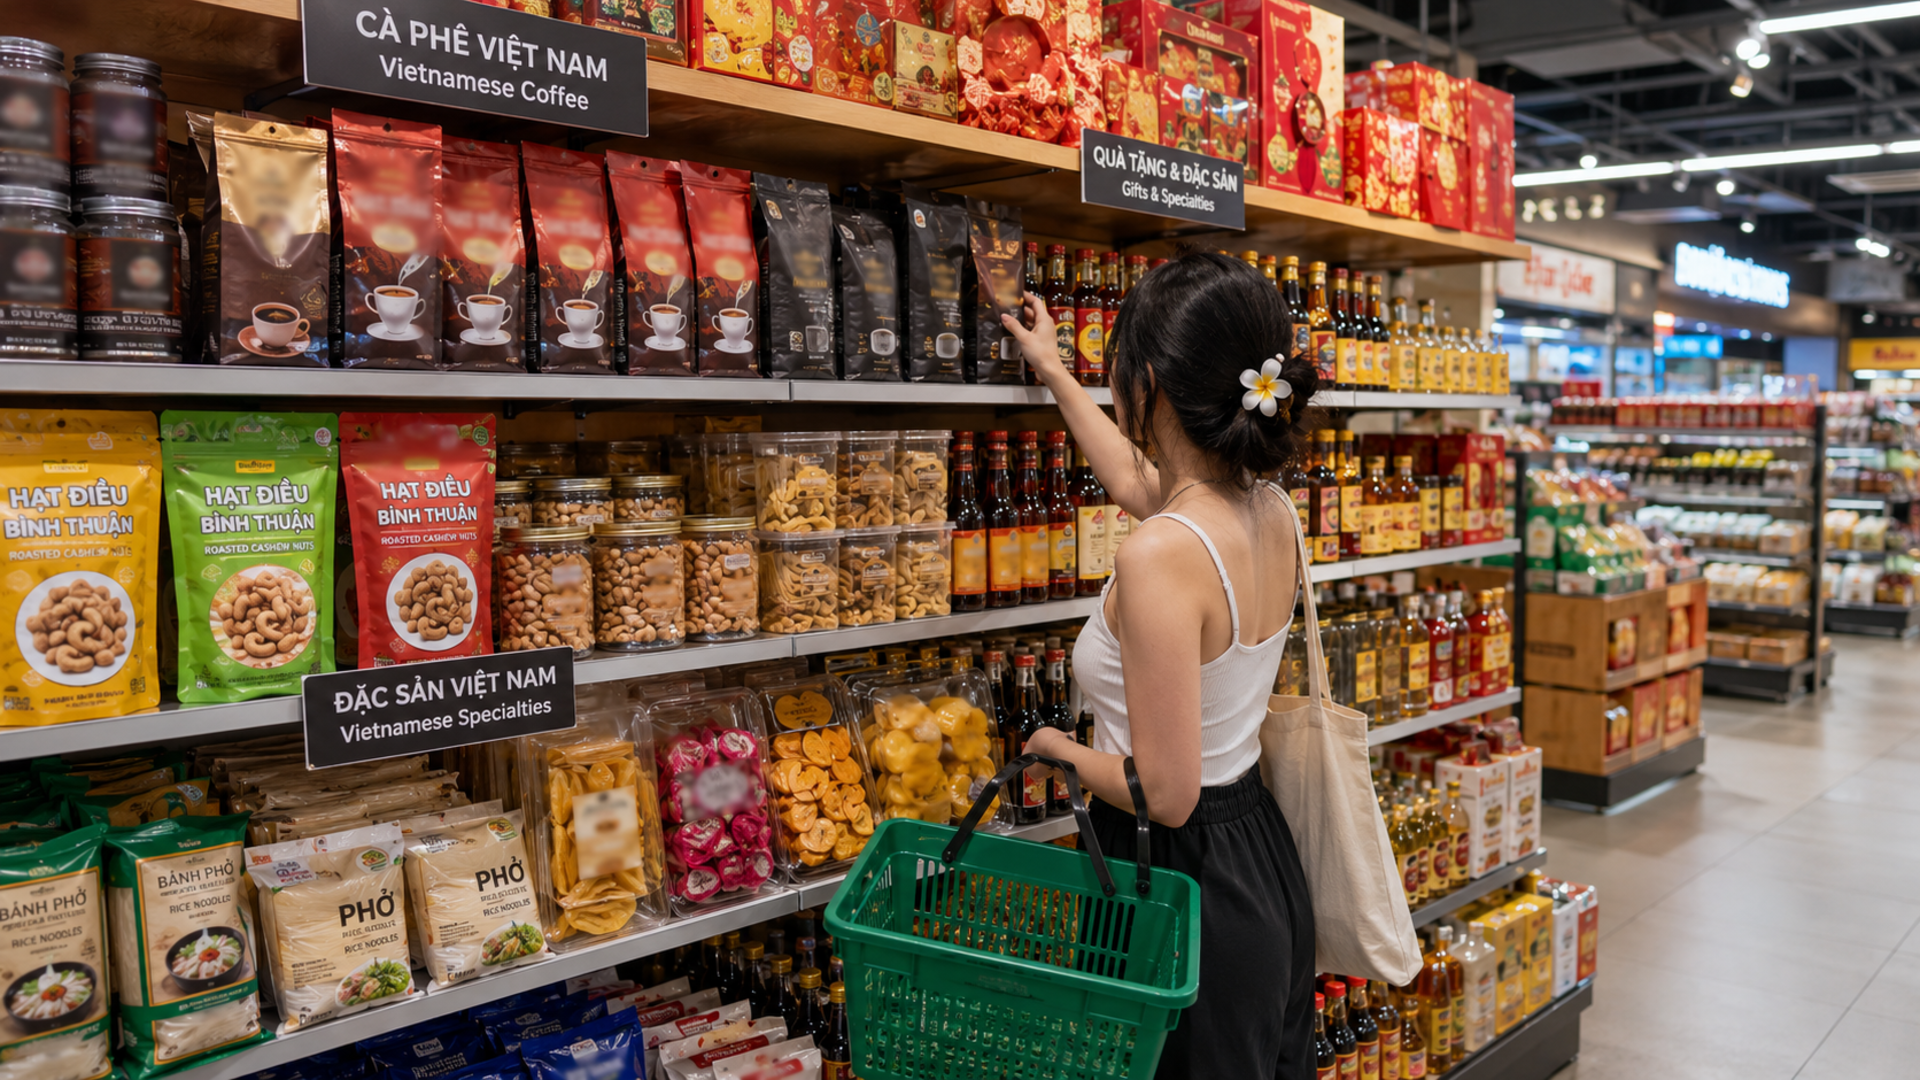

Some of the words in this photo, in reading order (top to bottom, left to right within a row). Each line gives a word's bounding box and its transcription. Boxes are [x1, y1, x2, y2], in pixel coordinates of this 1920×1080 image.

[356, 7, 401, 44] CÀ
[410, 20, 470, 56] PHÊ
[477, 34, 539, 71] VIỆT
[547, 48, 608, 82] NAM
[379, 55, 515, 98] Vietnamese
[521, 80, 589, 110] Coffee
[1093, 145, 1127, 170] QUÀ
[1128, 150, 1167, 178] TẶNG
[1169, 162, 1181, 182] &
[1182, 162, 1210, 190] ĐẶC
[1212, 167, 1238, 193] SẢN
[1122, 180, 1149, 200] Gifts
[1150, 186, 1160, 202] &
[1161, 188, 1215, 212] Specialties
[8, 486, 62, 513] HẠT
[66, 477, 128, 508] ĐIỀU
[203, 485, 252, 511] HẠT
[255, 476, 310, 505] ĐIỀU
[379, 481, 420, 504] HẠT
[424, 473, 472, 499] ĐIỀU
[3, 514, 61, 539] BÌNH
[63, 510, 134, 540] THUẬN
[200, 510, 251, 534] BÌNH
[252, 508, 315, 535] THUẬN
[377, 504, 421, 526] BÌNH
[423, 502, 478, 526] THUẬN
[9, 548, 61, 561] ROASTED
[204, 543, 249, 556] ROASTED
[292, 540, 315, 551] NUTS
[381, 534, 421, 546] ROASTED
[333, 684, 388, 716] ĐẶC
[395, 675, 445, 705] SẢN
[450, 669, 500, 700] VIỆT
[506, 666, 557, 691] NAM
[340, 714, 453, 744] Vietnamese
[458, 699, 552, 728] Specialties
[474, 855, 525, 893] PHỞ
[169, 901, 192, 915] RICE
[338, 887, 395, 928] PHỞ
[12, 935, 37, 949] RICE
